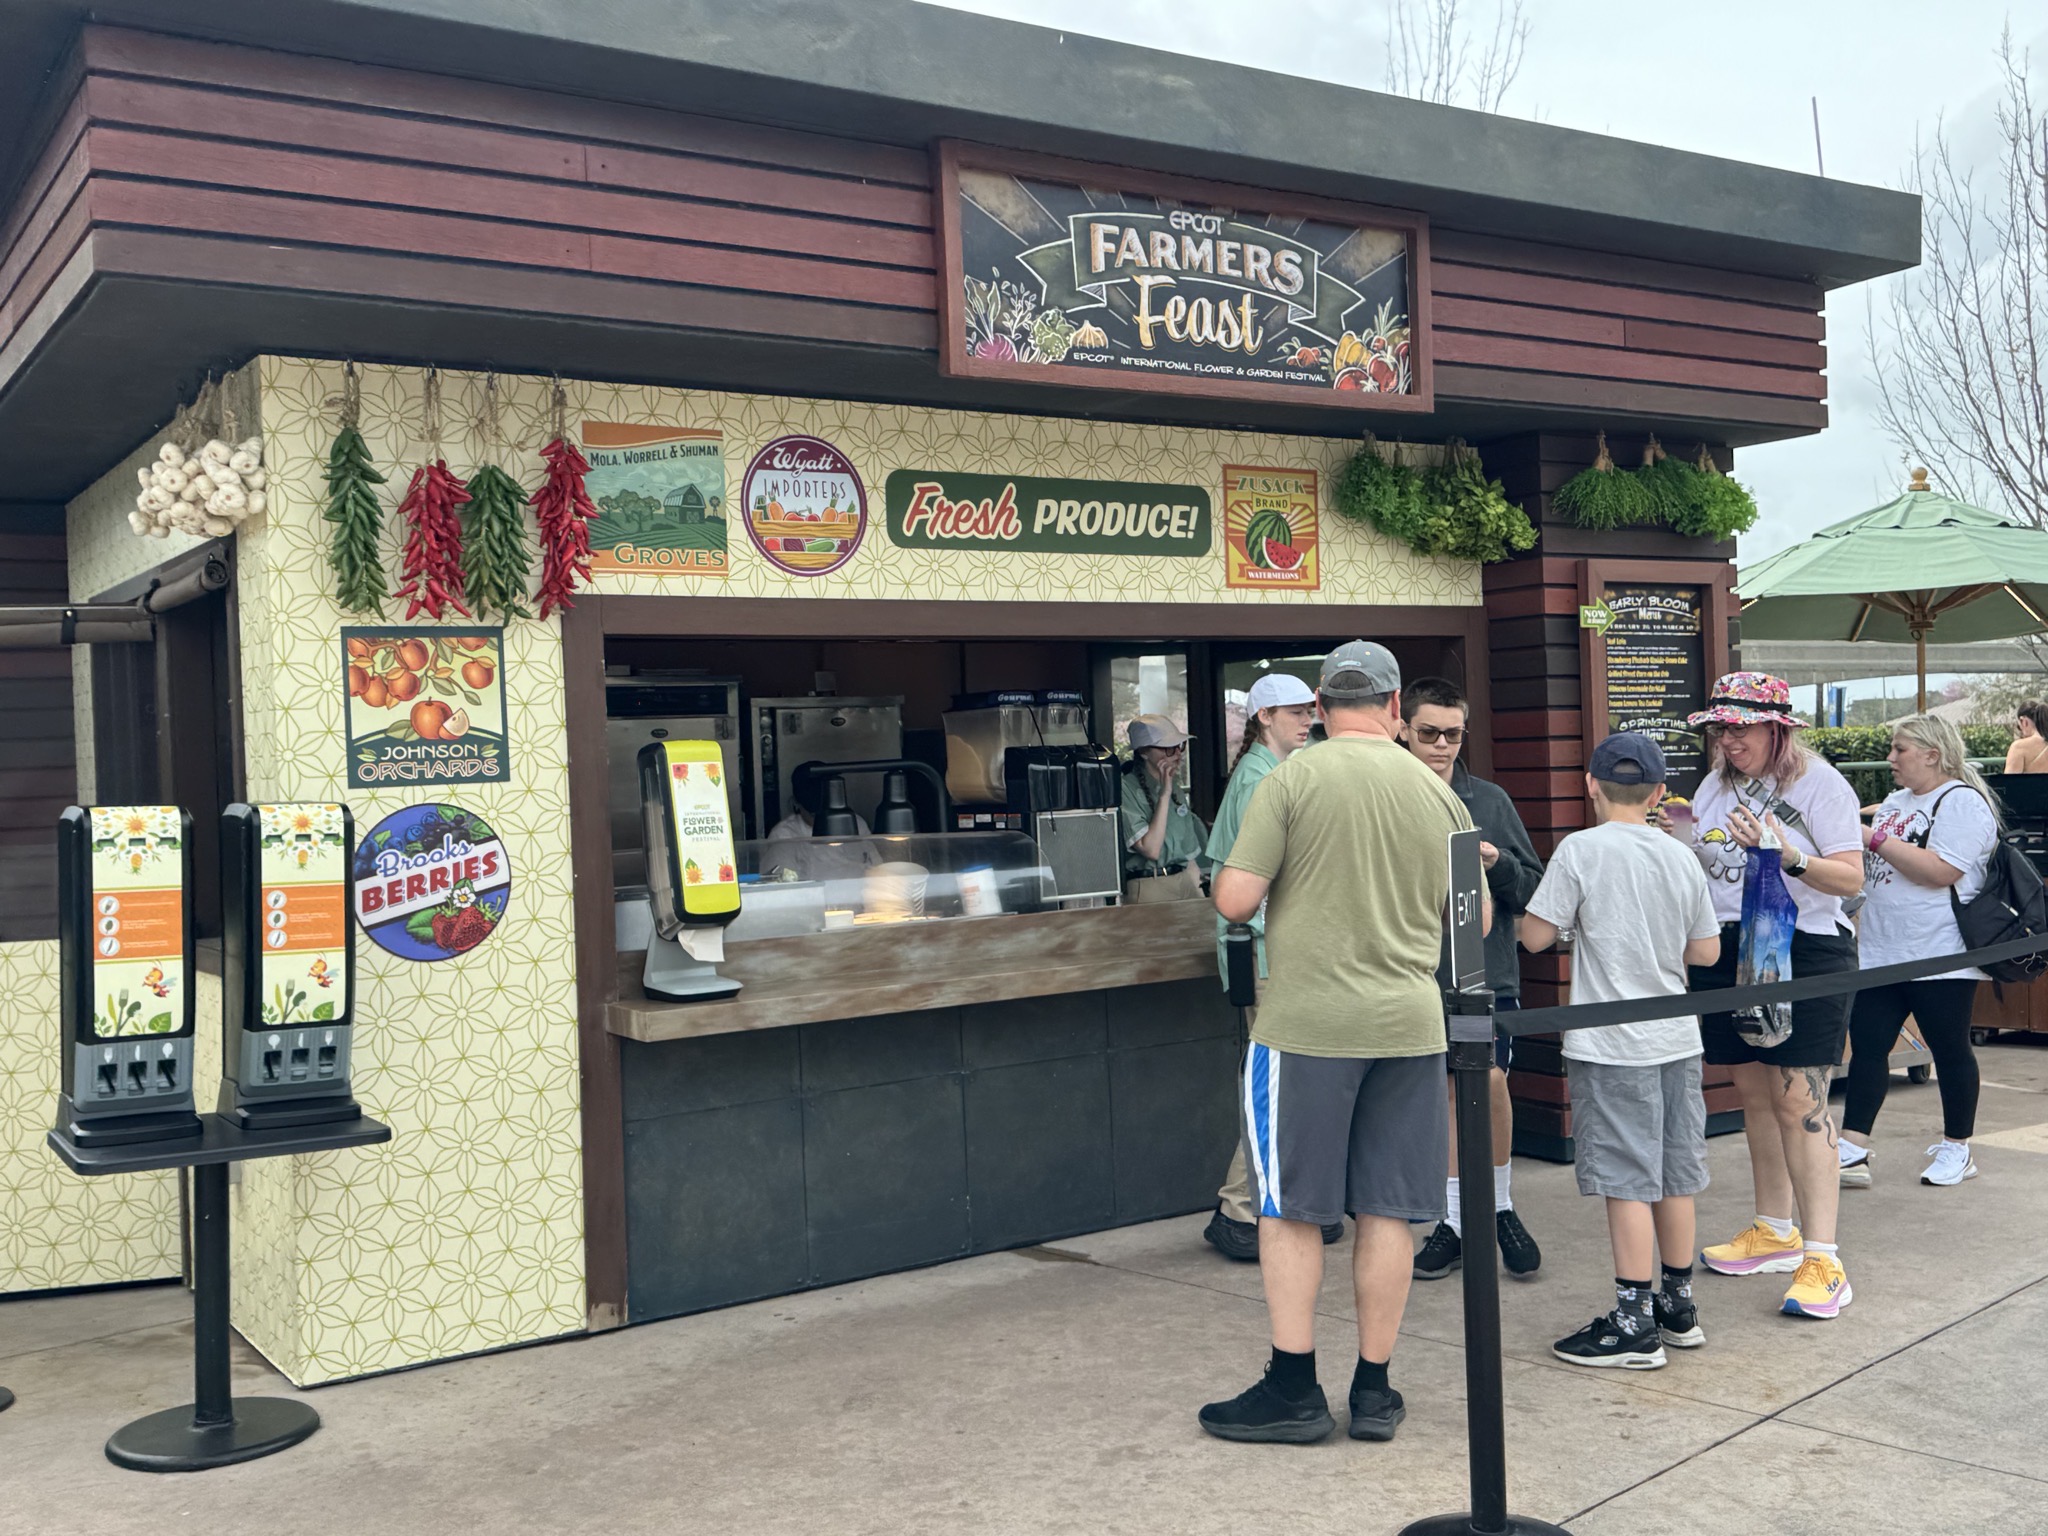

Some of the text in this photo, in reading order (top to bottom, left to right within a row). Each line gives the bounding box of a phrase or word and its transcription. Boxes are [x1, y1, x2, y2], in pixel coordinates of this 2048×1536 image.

[1090, 222, 1304, 295] FARMERS
[1132, 274, 1263, 354] Feast
[1121, 357, 1191, 371] INTERNATIONAL
[1194, 363, 1234, 375] FLOWER
[1236, 368, 1244, 376] &
[1247, 369, 1283, 379] GARDEN
[1285, 372, 1326, 382] FESTIVAL
[623, 448, 668, 464] WORRELL
[670, 445, 678, 459] &
[680, 444, 719, 457] SHUMAN
[772, 447, 834, 478] Wyatt
[763, 478, 846, 499] IMPORTERS
[1236, 475, 1306, 494] ZUSACK
[903, 482, 1198, 540] Fresh PRODUCE!
[1255, 498, 1288, 509] BRAND
[613, 542, 725, 567] GROVES
[1248, 571, 1299, 580] WATERMELONS
[1584, 609, 1608, 618] NOW
[1609, 595, 1690, 611] EARLY BLOOM
[1619, 717, 1687, 731] SPRINGTIME
[381, 744, 478, 760] JOHNSON
[358, 758, 500, 781] ORCHARDS
[682, 816, 716, 826] FLOWER
[684, 825, 724, 836] GARDEN
[376, 833, 475, 878] Brooks
[362, 850, 500, 916] BERRIES
[1457, 889, 1477, 926] EXIT
